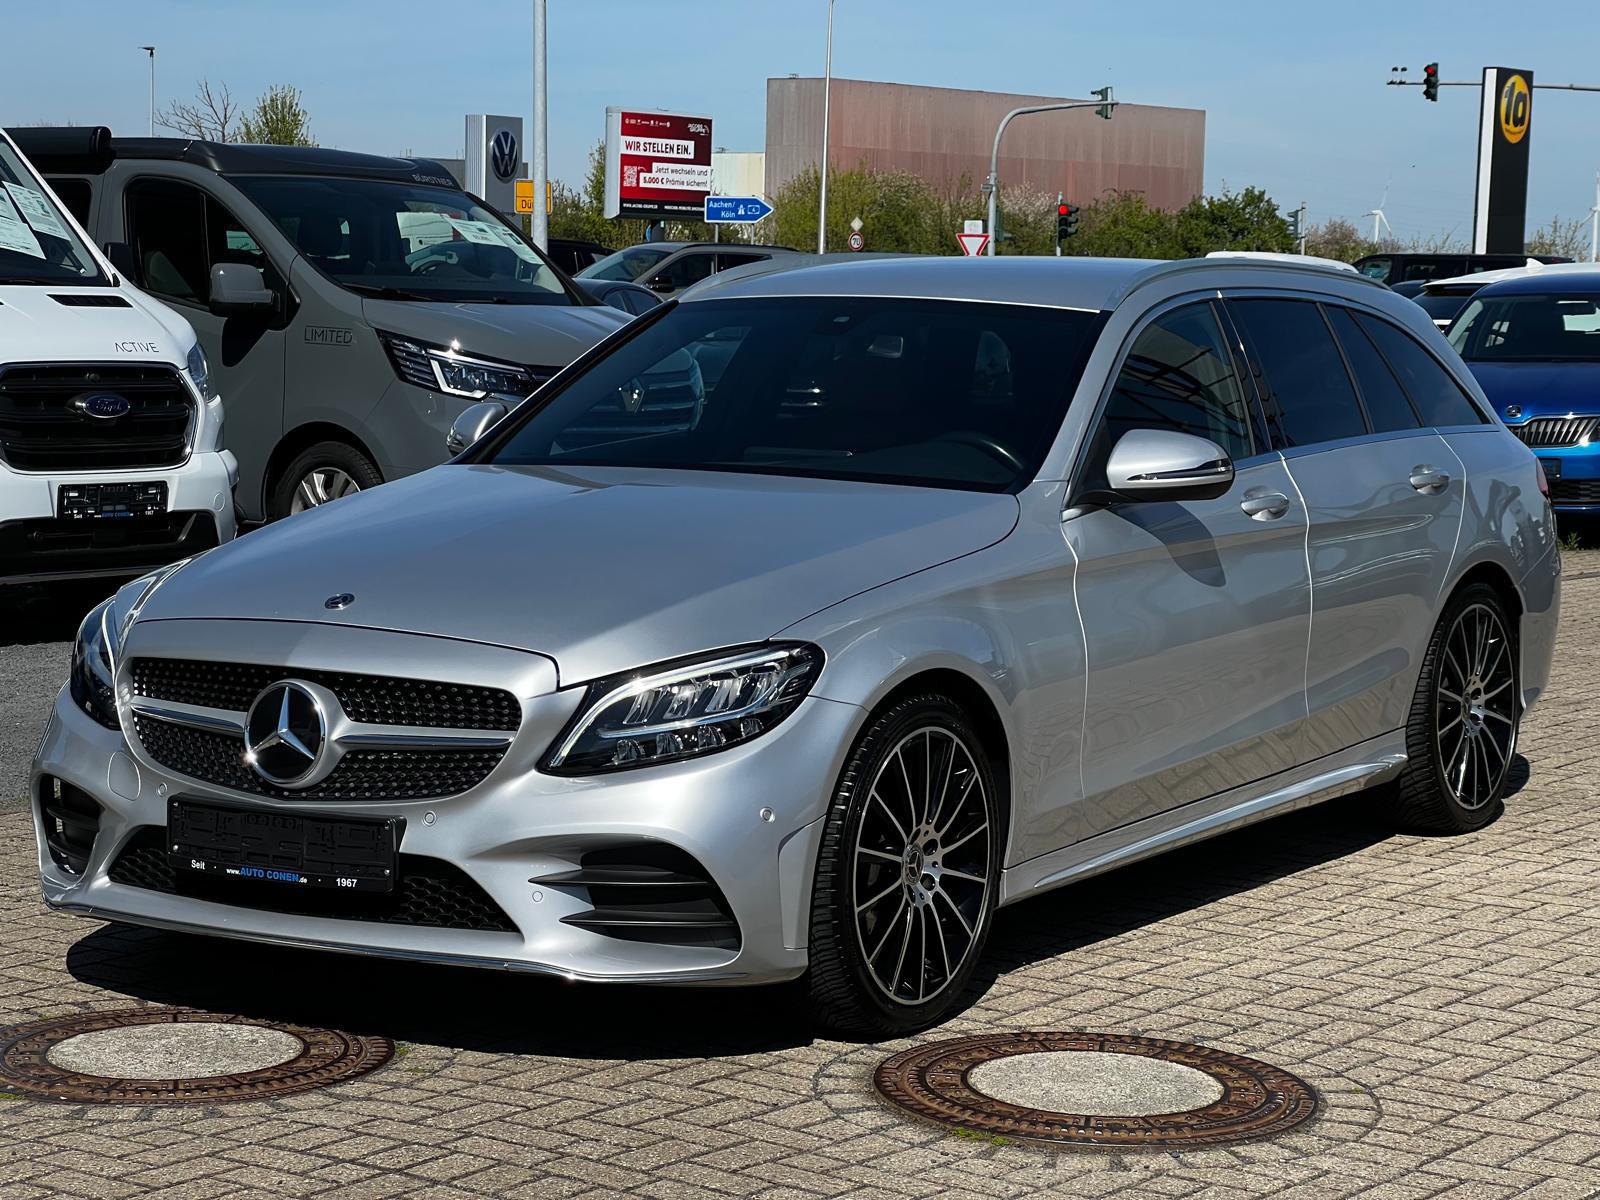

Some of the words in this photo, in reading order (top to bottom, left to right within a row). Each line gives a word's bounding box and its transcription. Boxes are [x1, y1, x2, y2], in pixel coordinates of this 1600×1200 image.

[1504, 82, 1527, 128] 1a
[625, 140, 641, 151] WIR
[643, 142, 674, 154] STELLEN
[676, 144, 691, 155] EIN.
[655, 166, 669, 174] Jetzt
[670, 167, 696, 175] wechseln
[643, 176, 660, 184] 5.000
[665, 178, 684, 186] Prämie
[521, 199, 534, 209] Dü
[852, 237, 860, 246] 70
[304, 327, 353, 344] LIMITED
[114, 342, 159, 353] ACTIVE
[191, 859, 206, 870] Seit
[335, 877, 358, 888] 1967
